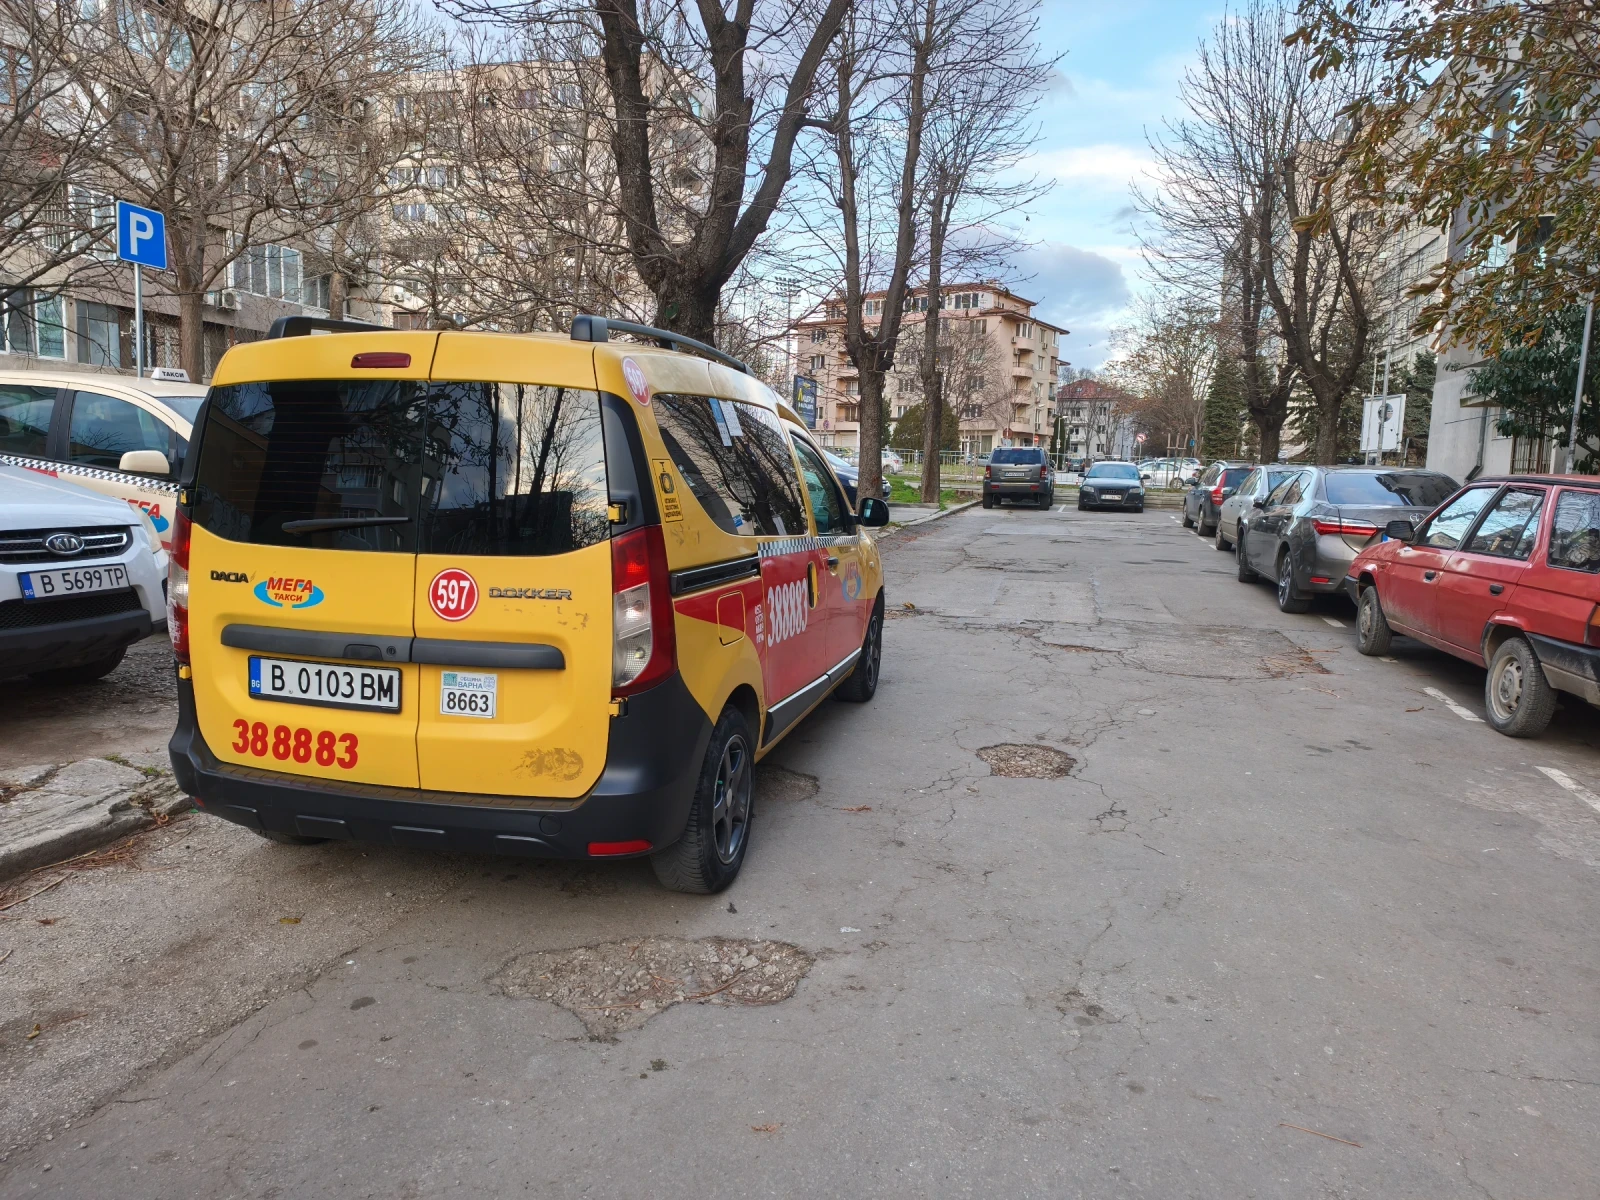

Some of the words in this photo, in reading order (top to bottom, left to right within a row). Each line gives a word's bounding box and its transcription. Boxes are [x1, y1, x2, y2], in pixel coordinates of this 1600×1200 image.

[130, 211, 154, 256] P
[53, 536, 80, 551] KIA
[61, 569, 103, 591] 5699
[210, 570, 249, 583] DACIA
[24, 588, 34, 596] BG
[266, 576, 313, 594] МЕГА
[273, 592, 303, 603] ТАКСИ
[437, 579, 470, 610] 597
[489, 587, 572, 601] DOKKER
[767, 577, 808, 648] 388883
[251, 679, 261, 688] BG
[457, 681, 484, 690] ВАРНА
[446, 691, 490, 713] 8663
[231, 718, 359, 770] 388883
